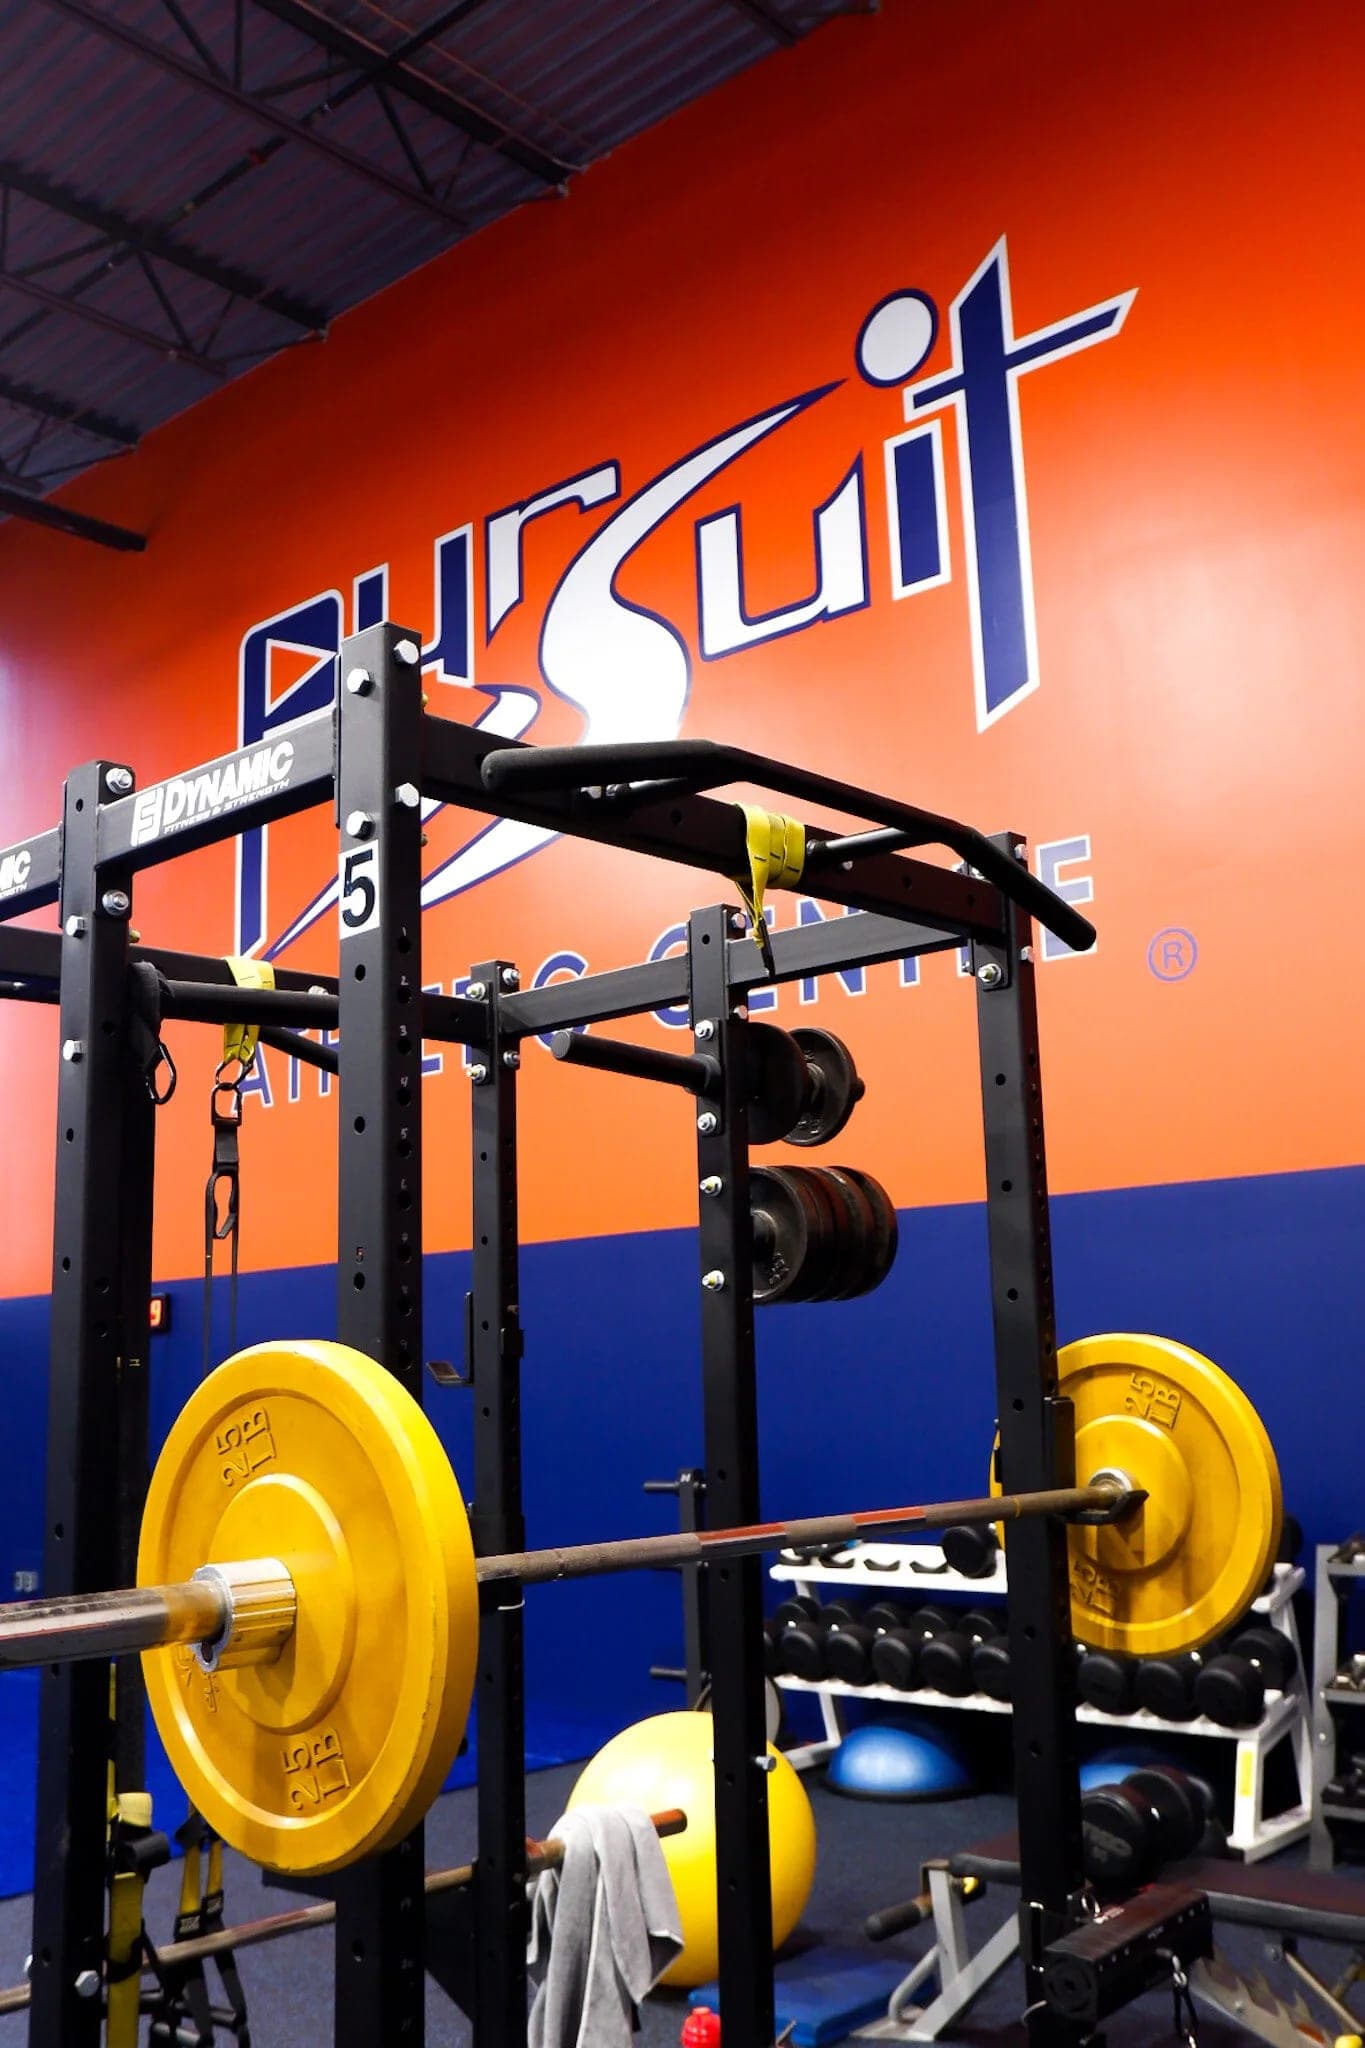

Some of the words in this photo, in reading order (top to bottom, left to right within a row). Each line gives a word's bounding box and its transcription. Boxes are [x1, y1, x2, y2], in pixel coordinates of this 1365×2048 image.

[163, 740, 295, 826] DYNAMIC
[341, 849, 377, 929] 5
[400, 975, 409, 986] 2
[399, 1024, 408, 1037] 3
[400, 1076, 409, 1088] 4
[1125, 1372, 1156, 1420] 25
[1148, 1385, 1182, 1433] LB
[215, 1424, 251, 1488] 25
[242, 1406, 278, 1473] LB
[282, 1741, 322, 1812] 25
[312, 1727, 353, 1800] LB
